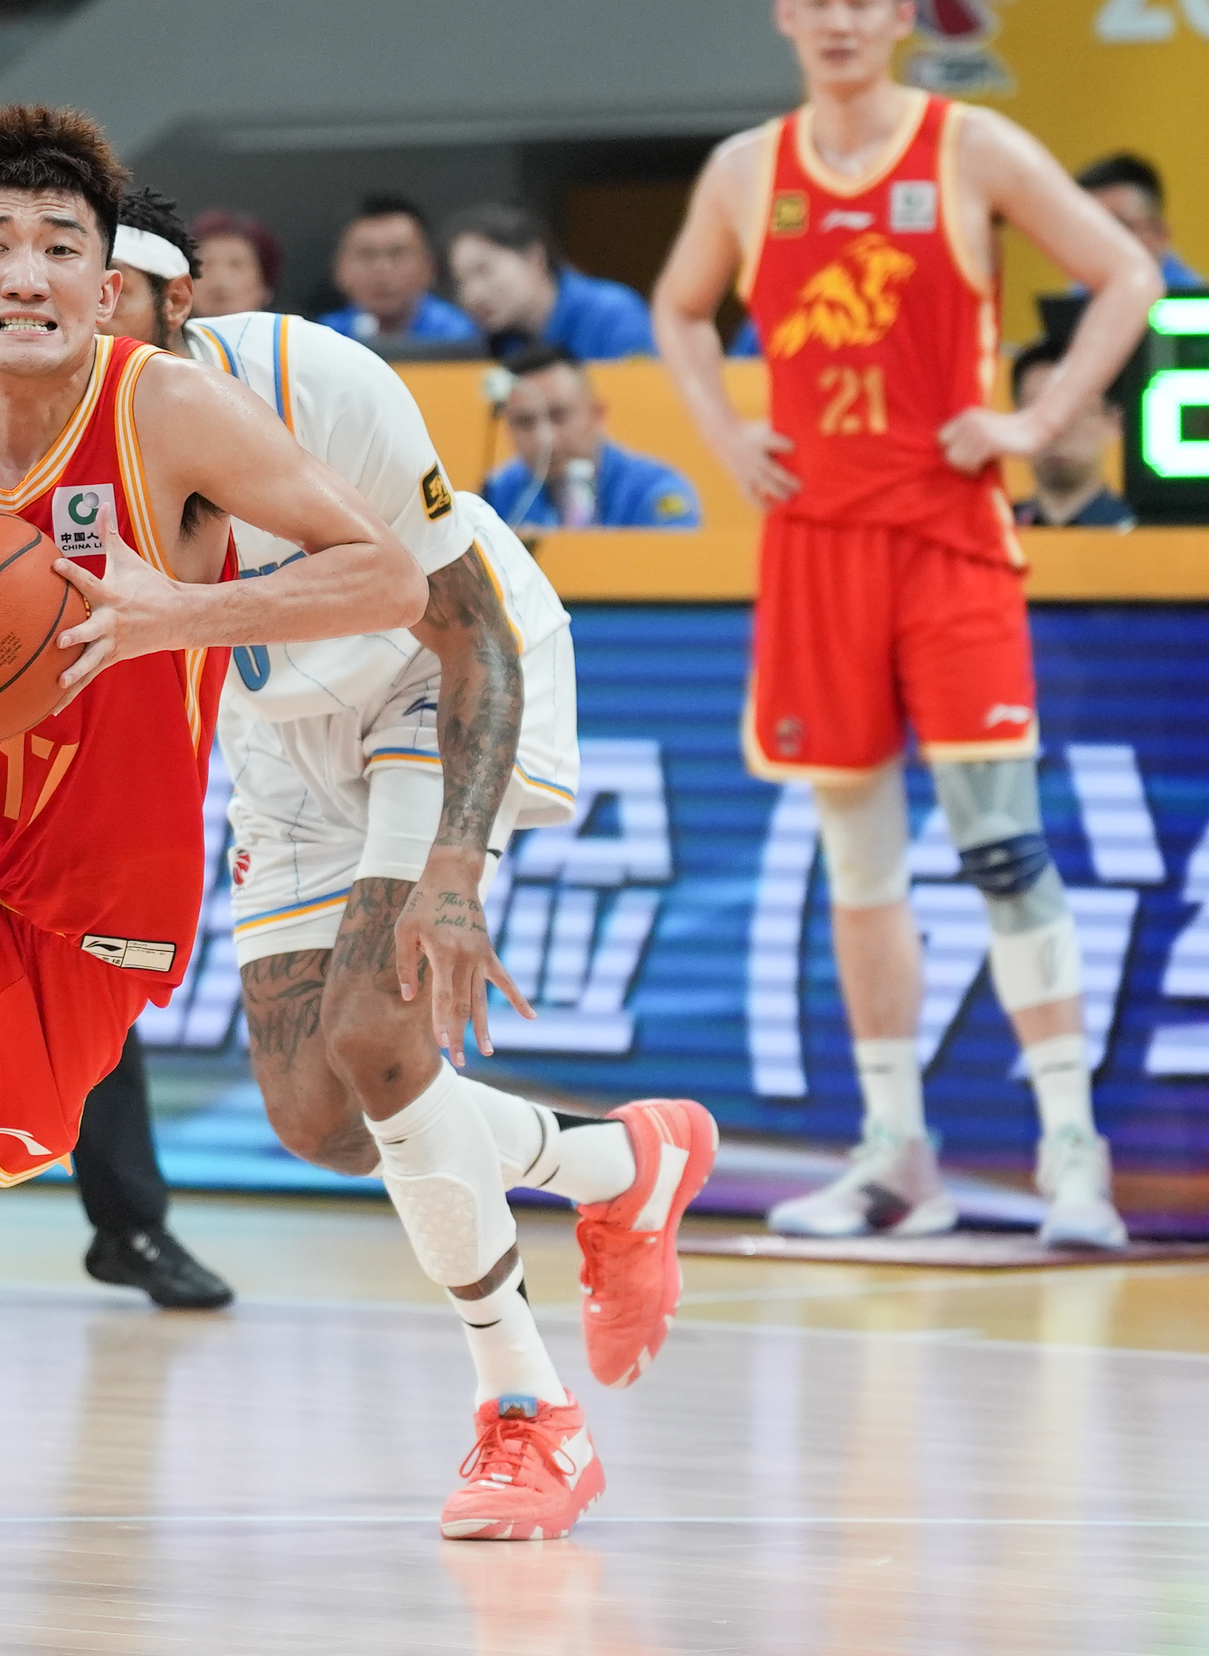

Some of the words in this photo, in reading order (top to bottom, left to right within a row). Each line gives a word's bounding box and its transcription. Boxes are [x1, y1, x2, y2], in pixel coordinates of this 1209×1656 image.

[818, 365, 889, 435] 21
[60, 532, 100, 544] 中国人
[62, 543, 92, 551] CHINA
